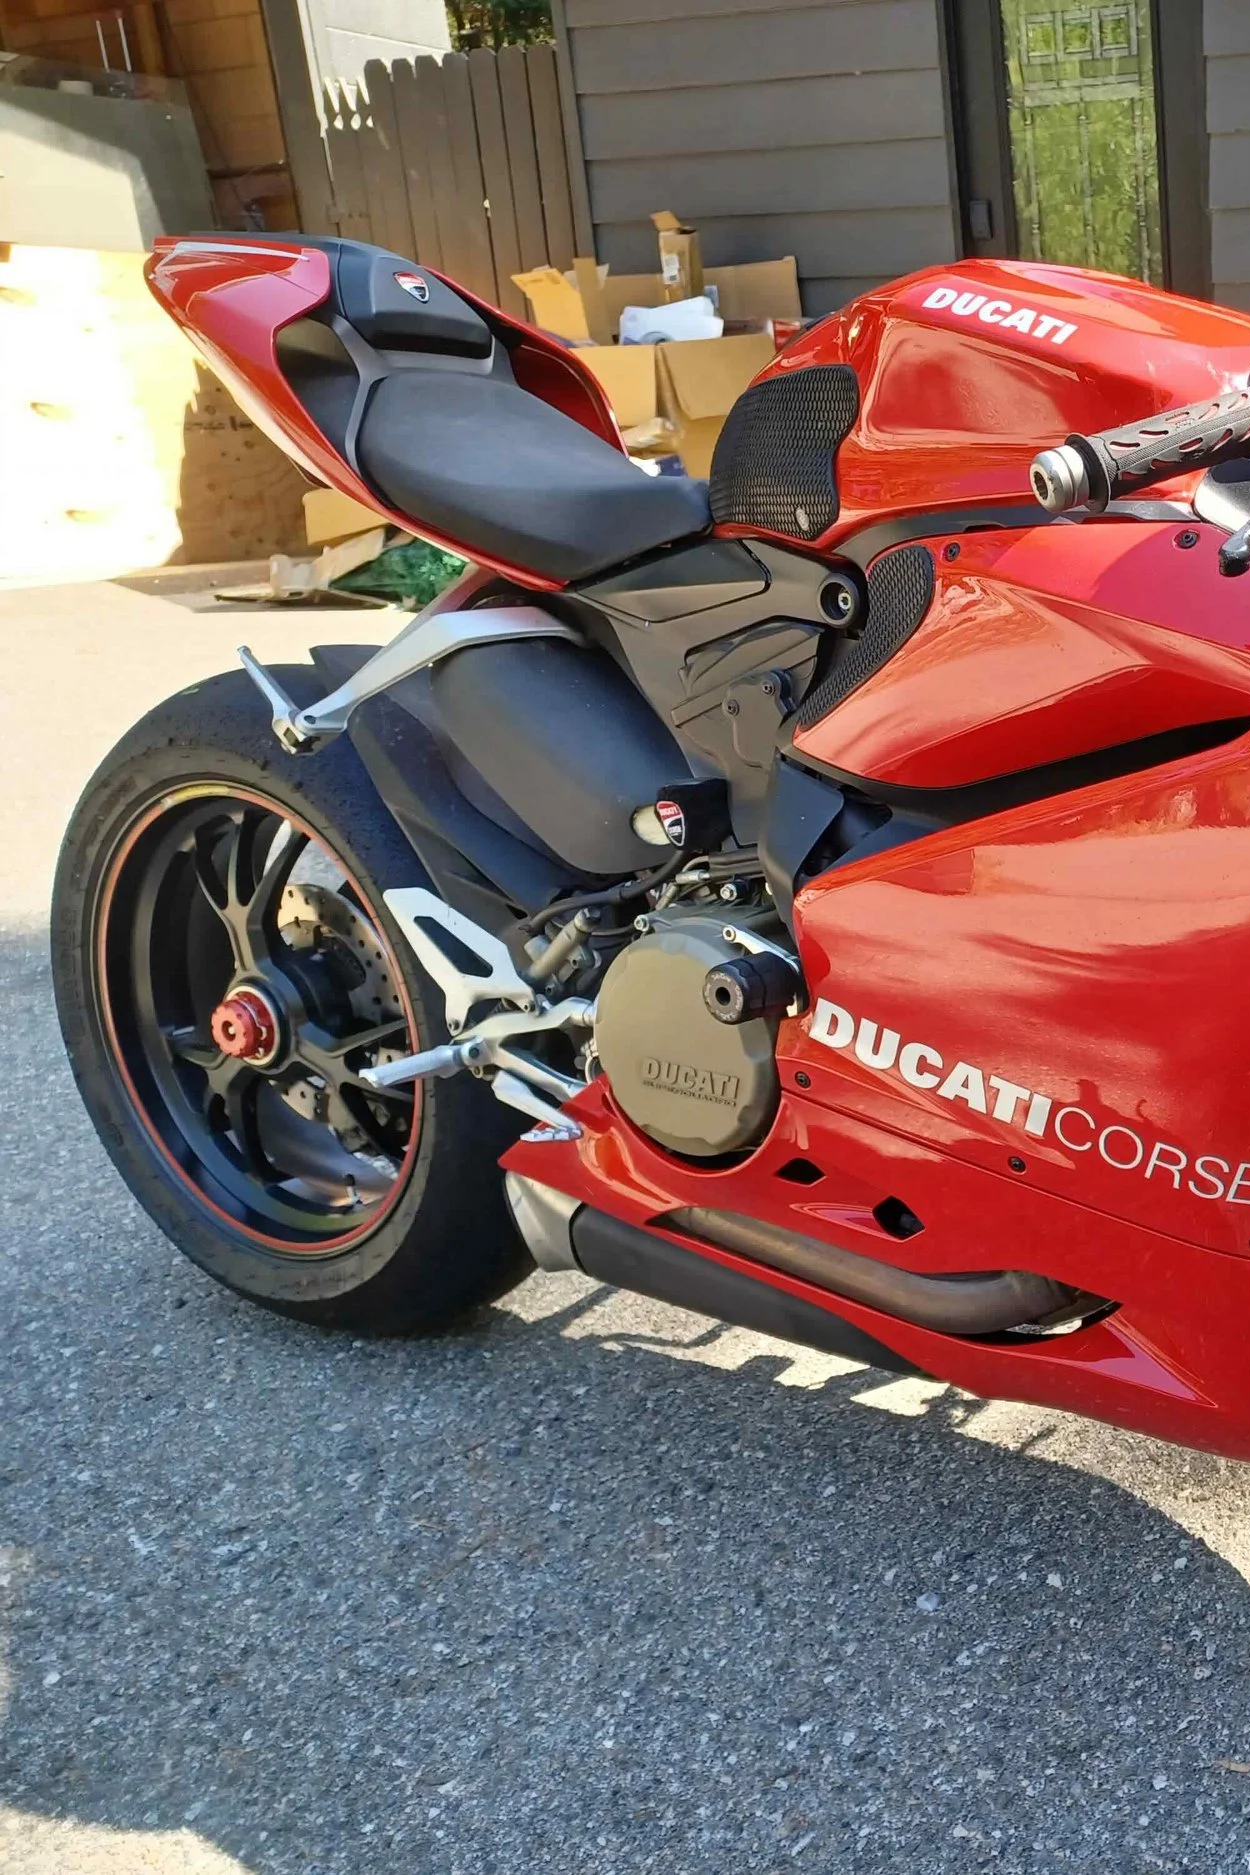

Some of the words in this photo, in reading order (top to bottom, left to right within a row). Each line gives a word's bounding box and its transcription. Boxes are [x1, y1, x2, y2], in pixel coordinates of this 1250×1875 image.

[921, 287, 1079, 345] DUCATI
[641, 1056, 740, 1101] DUCATI
[808, 997, 1053, 1137] DUCATI
